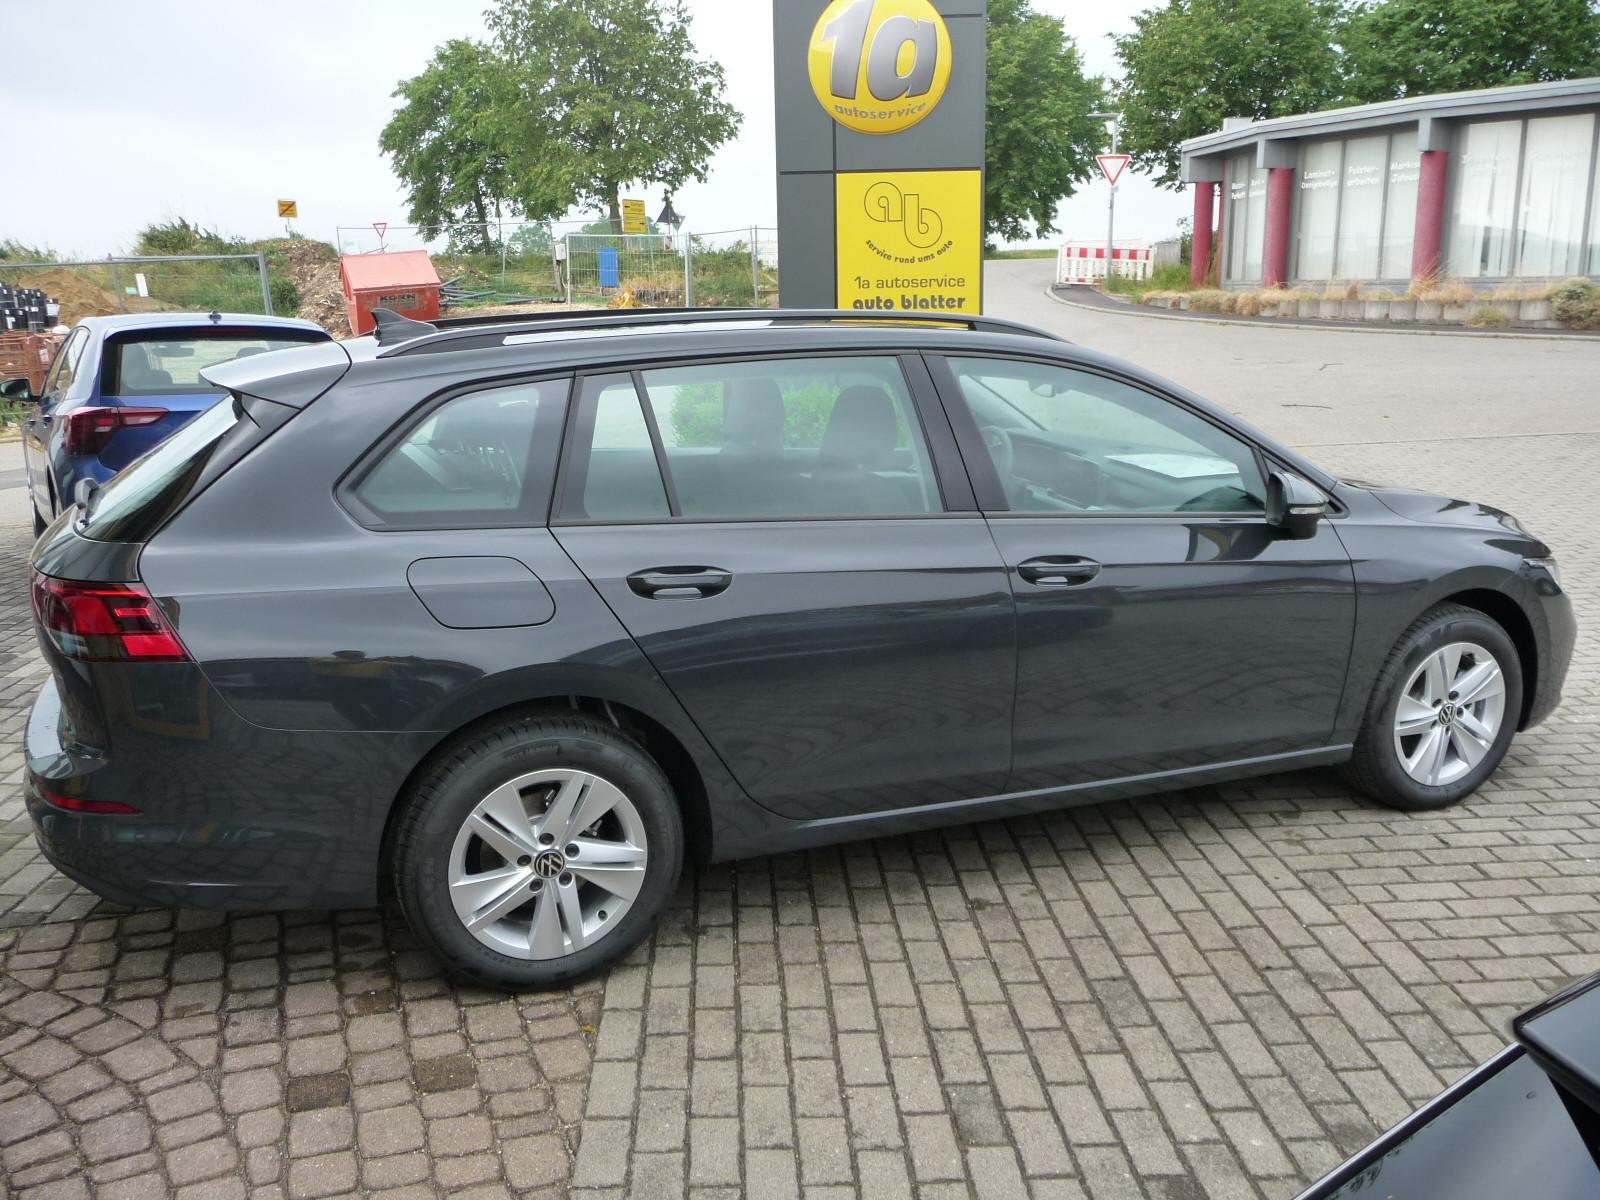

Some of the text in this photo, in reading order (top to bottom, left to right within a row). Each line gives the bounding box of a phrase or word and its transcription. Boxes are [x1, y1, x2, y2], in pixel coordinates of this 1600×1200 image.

[822, 0, 937, 101] 1a
[834, 102, 926, 119] autoservice
[866, 239, 953, 264] service rund ums auto
[854, 274, 965, 289] 1a autoservice
[853, 294, 966, 310] auto blatter
